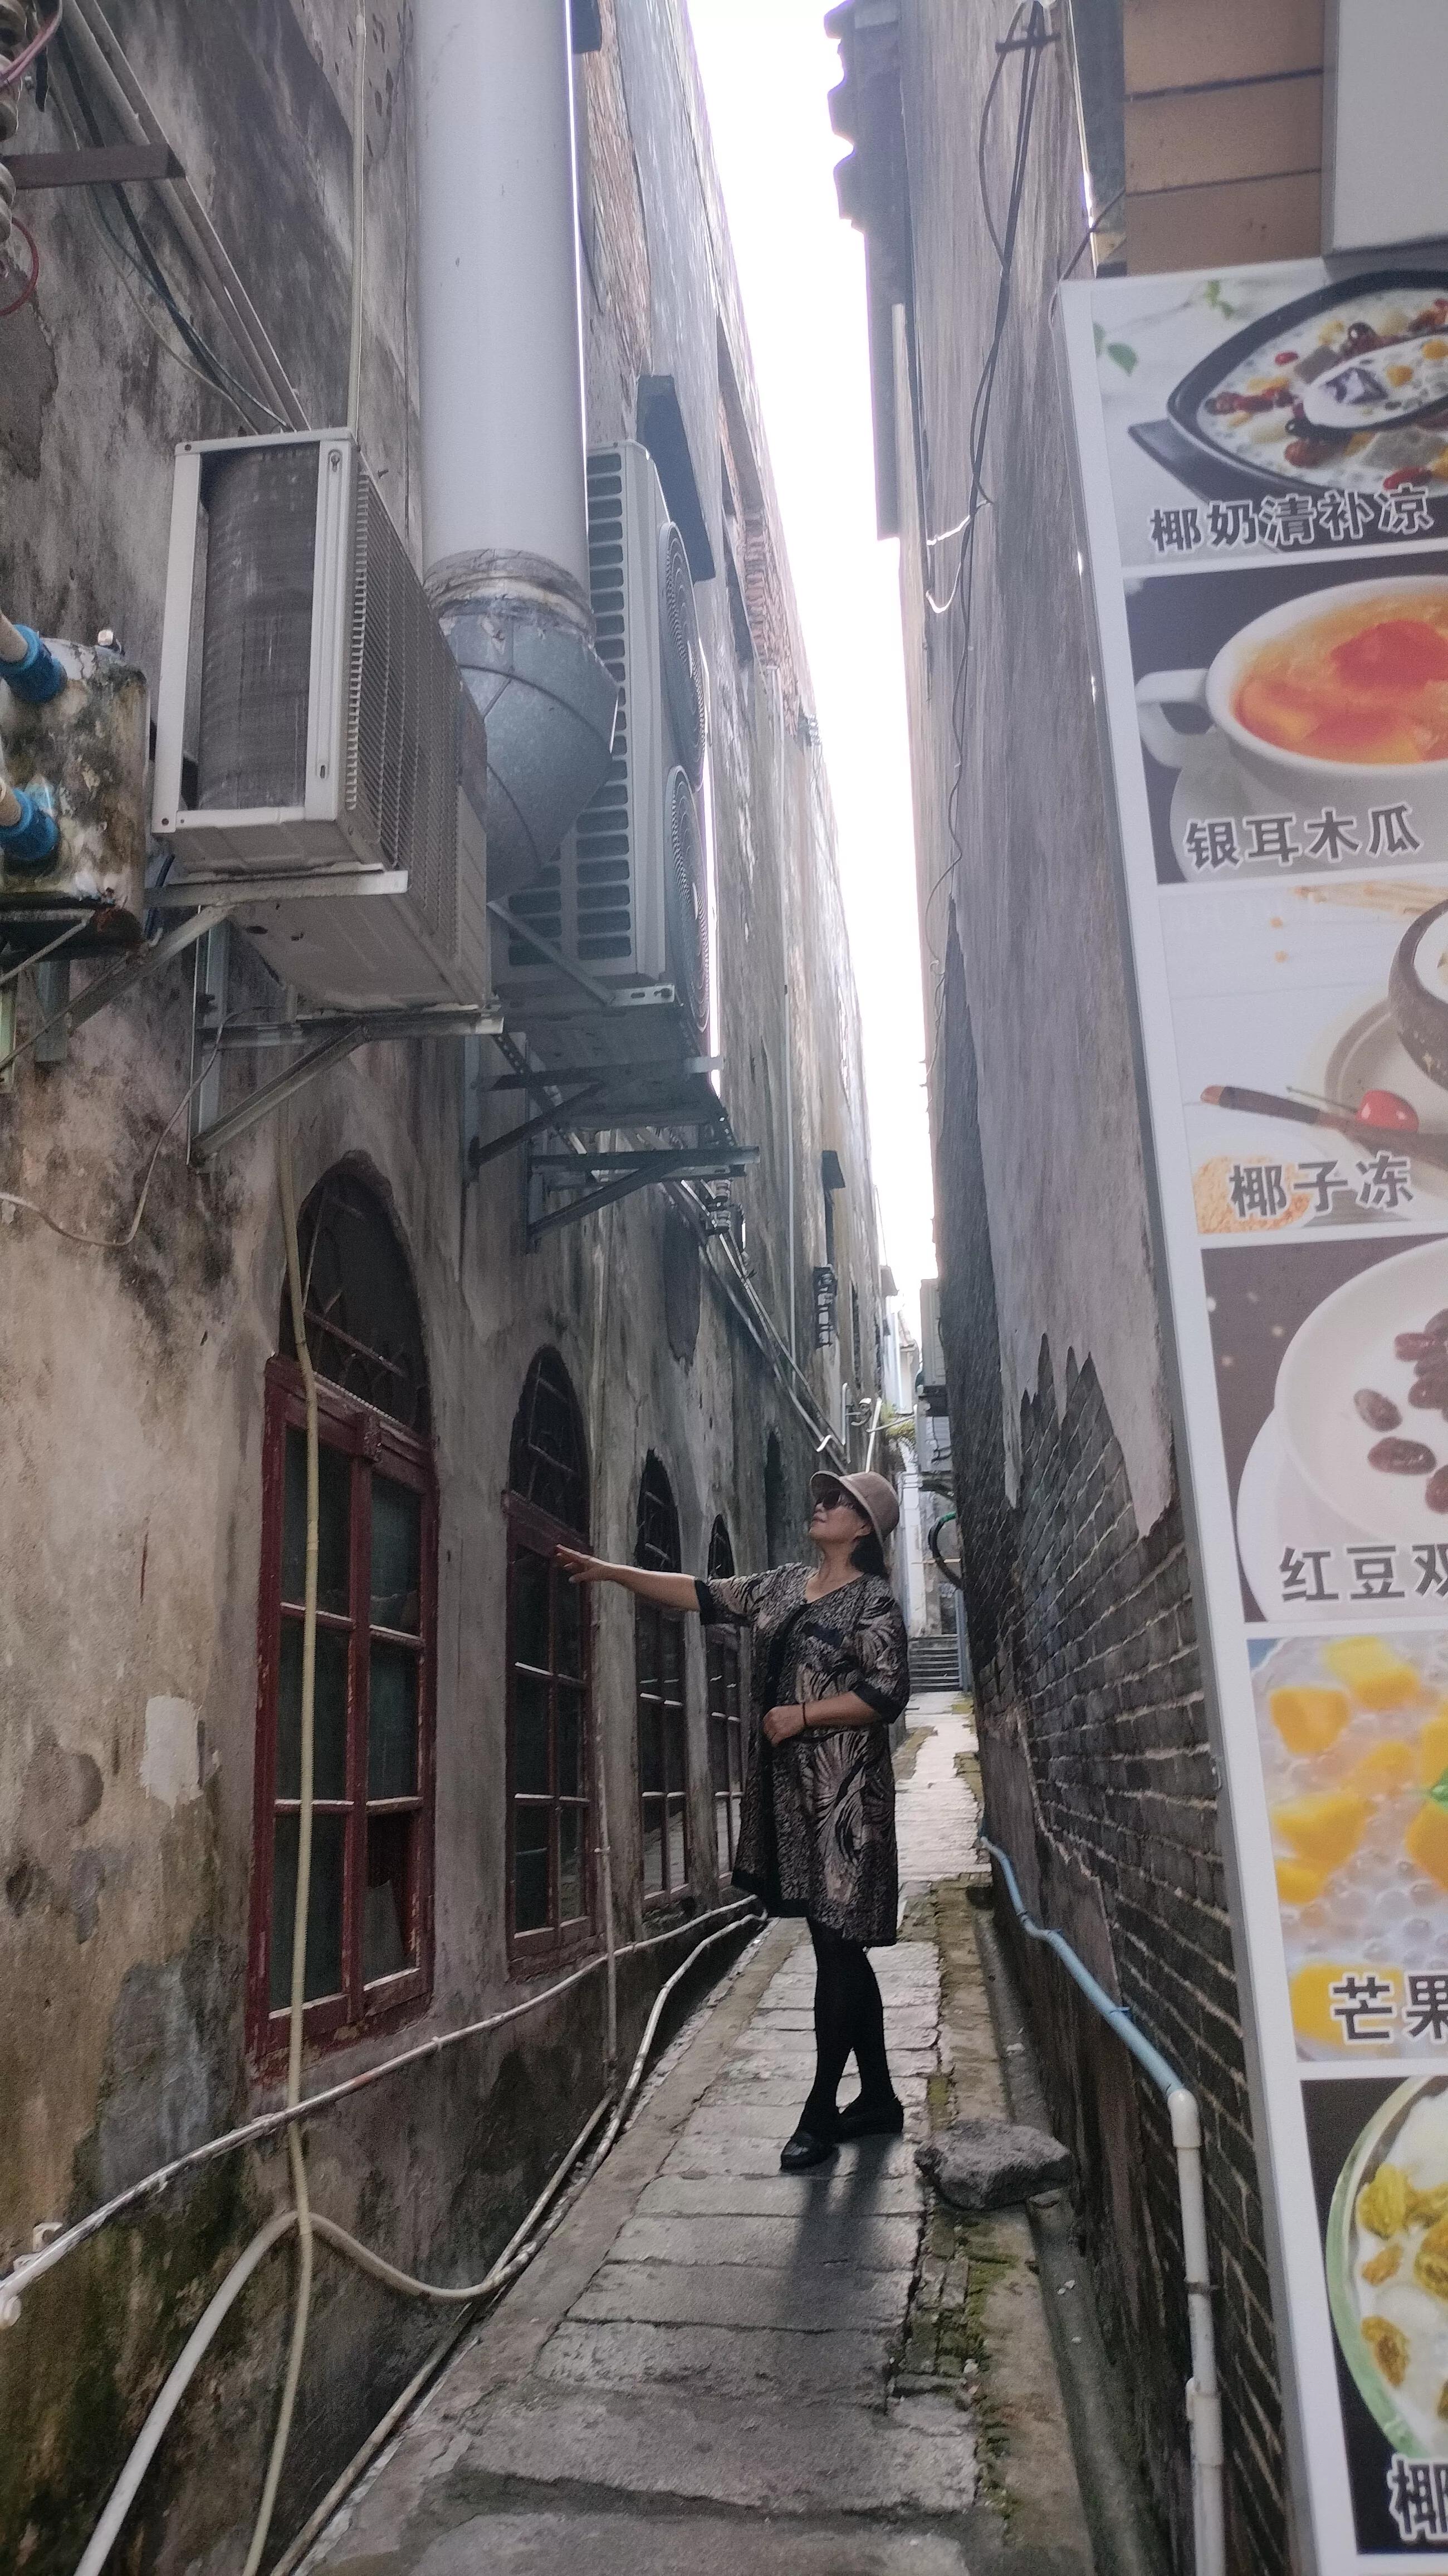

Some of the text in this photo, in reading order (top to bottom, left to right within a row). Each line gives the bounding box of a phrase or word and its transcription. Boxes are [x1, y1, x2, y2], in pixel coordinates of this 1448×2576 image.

[1149, 485, 1434, 552] 椰奶清补凉
[1186, 804, 1422, 870] 银耳木瓜
[1229, 1153, 1415, 1218] 椰子冻
[1332, 1973, 1448, 2041] 芒果
